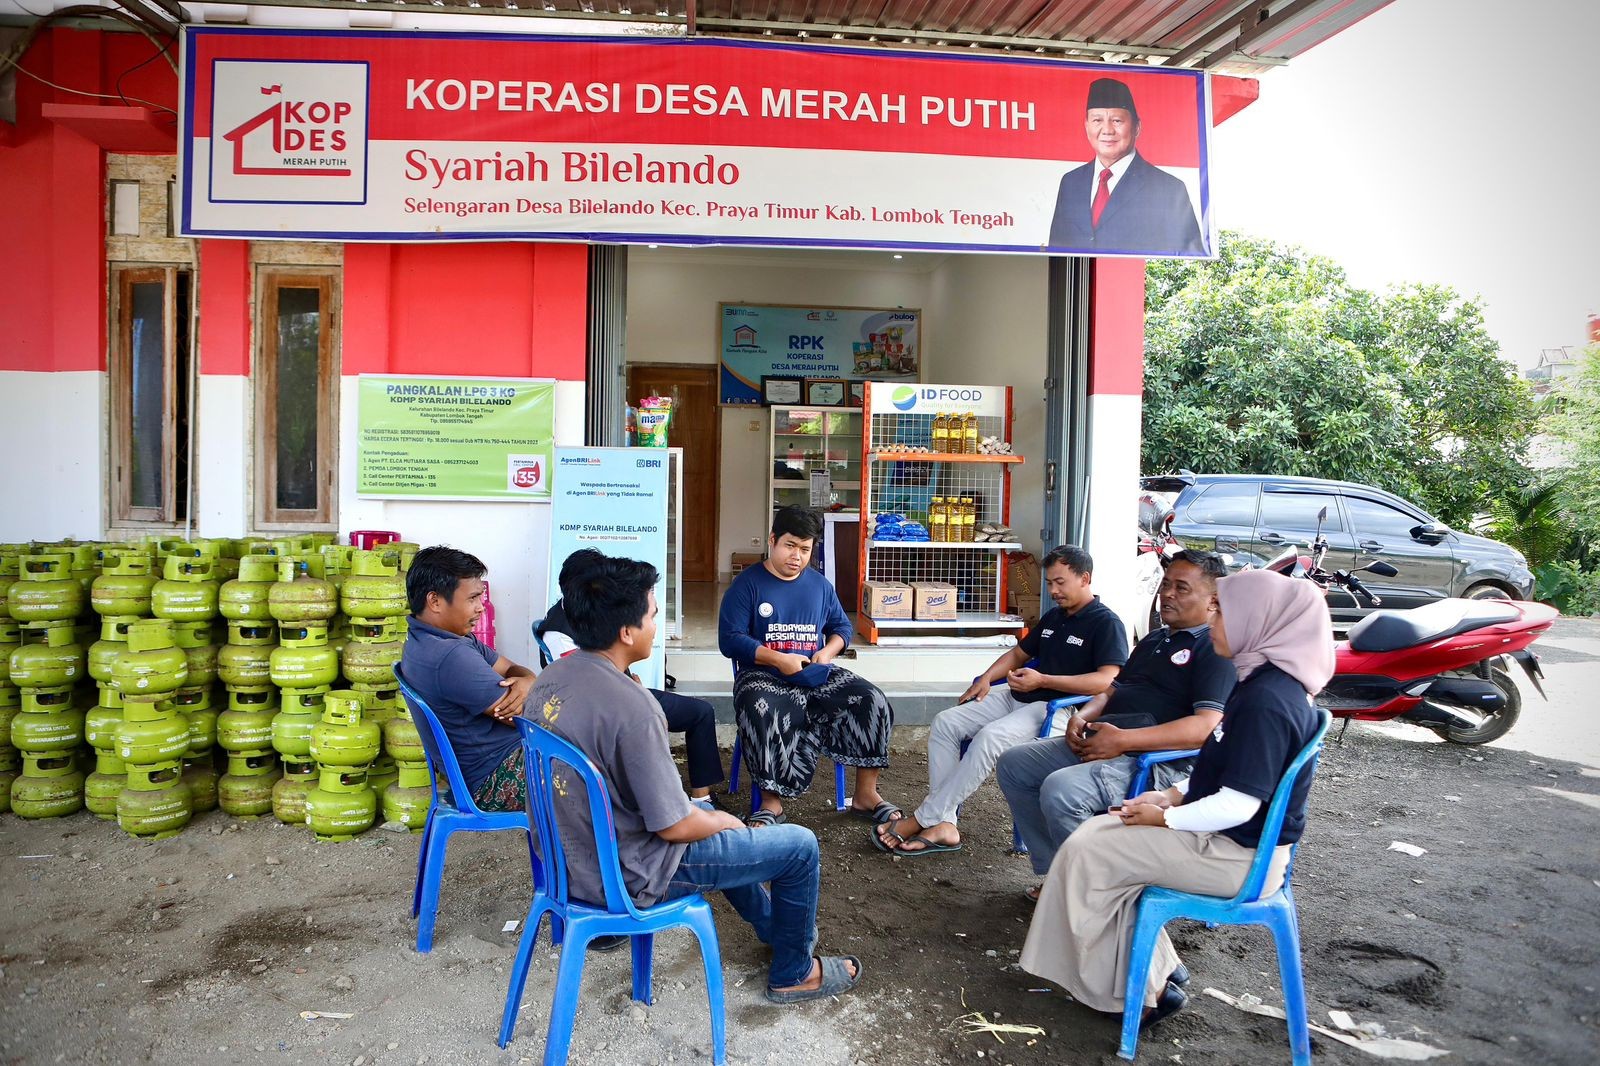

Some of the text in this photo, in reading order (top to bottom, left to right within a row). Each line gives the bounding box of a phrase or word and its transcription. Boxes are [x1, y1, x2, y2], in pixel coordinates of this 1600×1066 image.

[406, 78, 1036, 131] KOPERASI DESA MERAH PUTIH
[285, 101, 351, 124] KOP
[284, 129, 347, 151] DES
[283, 158, 347, 166] MERAH PUTIH
[404, 148, 740, 189] Syariah Bilelando
[404, 197, 1014, 230] Selengaran Desa Bilelando Kec. Praya Timur Kab. Lombok Tengah
[894, 313, 914, 321] bulog
[788, 335, 824, 350] RPK
[386, 384, 516, 398] PANGKALAN LPG 3 KG
[921, 388, 982, 401] ID FOOD
[460, 398, 512, 406] BILELANDO
[645, 460, 661, 468] BRI
[514, 471, 537, 484] 135
[768, 623, 816, 632] BERDAYAKAN
[796, 633, 818, 642] UNTUK
